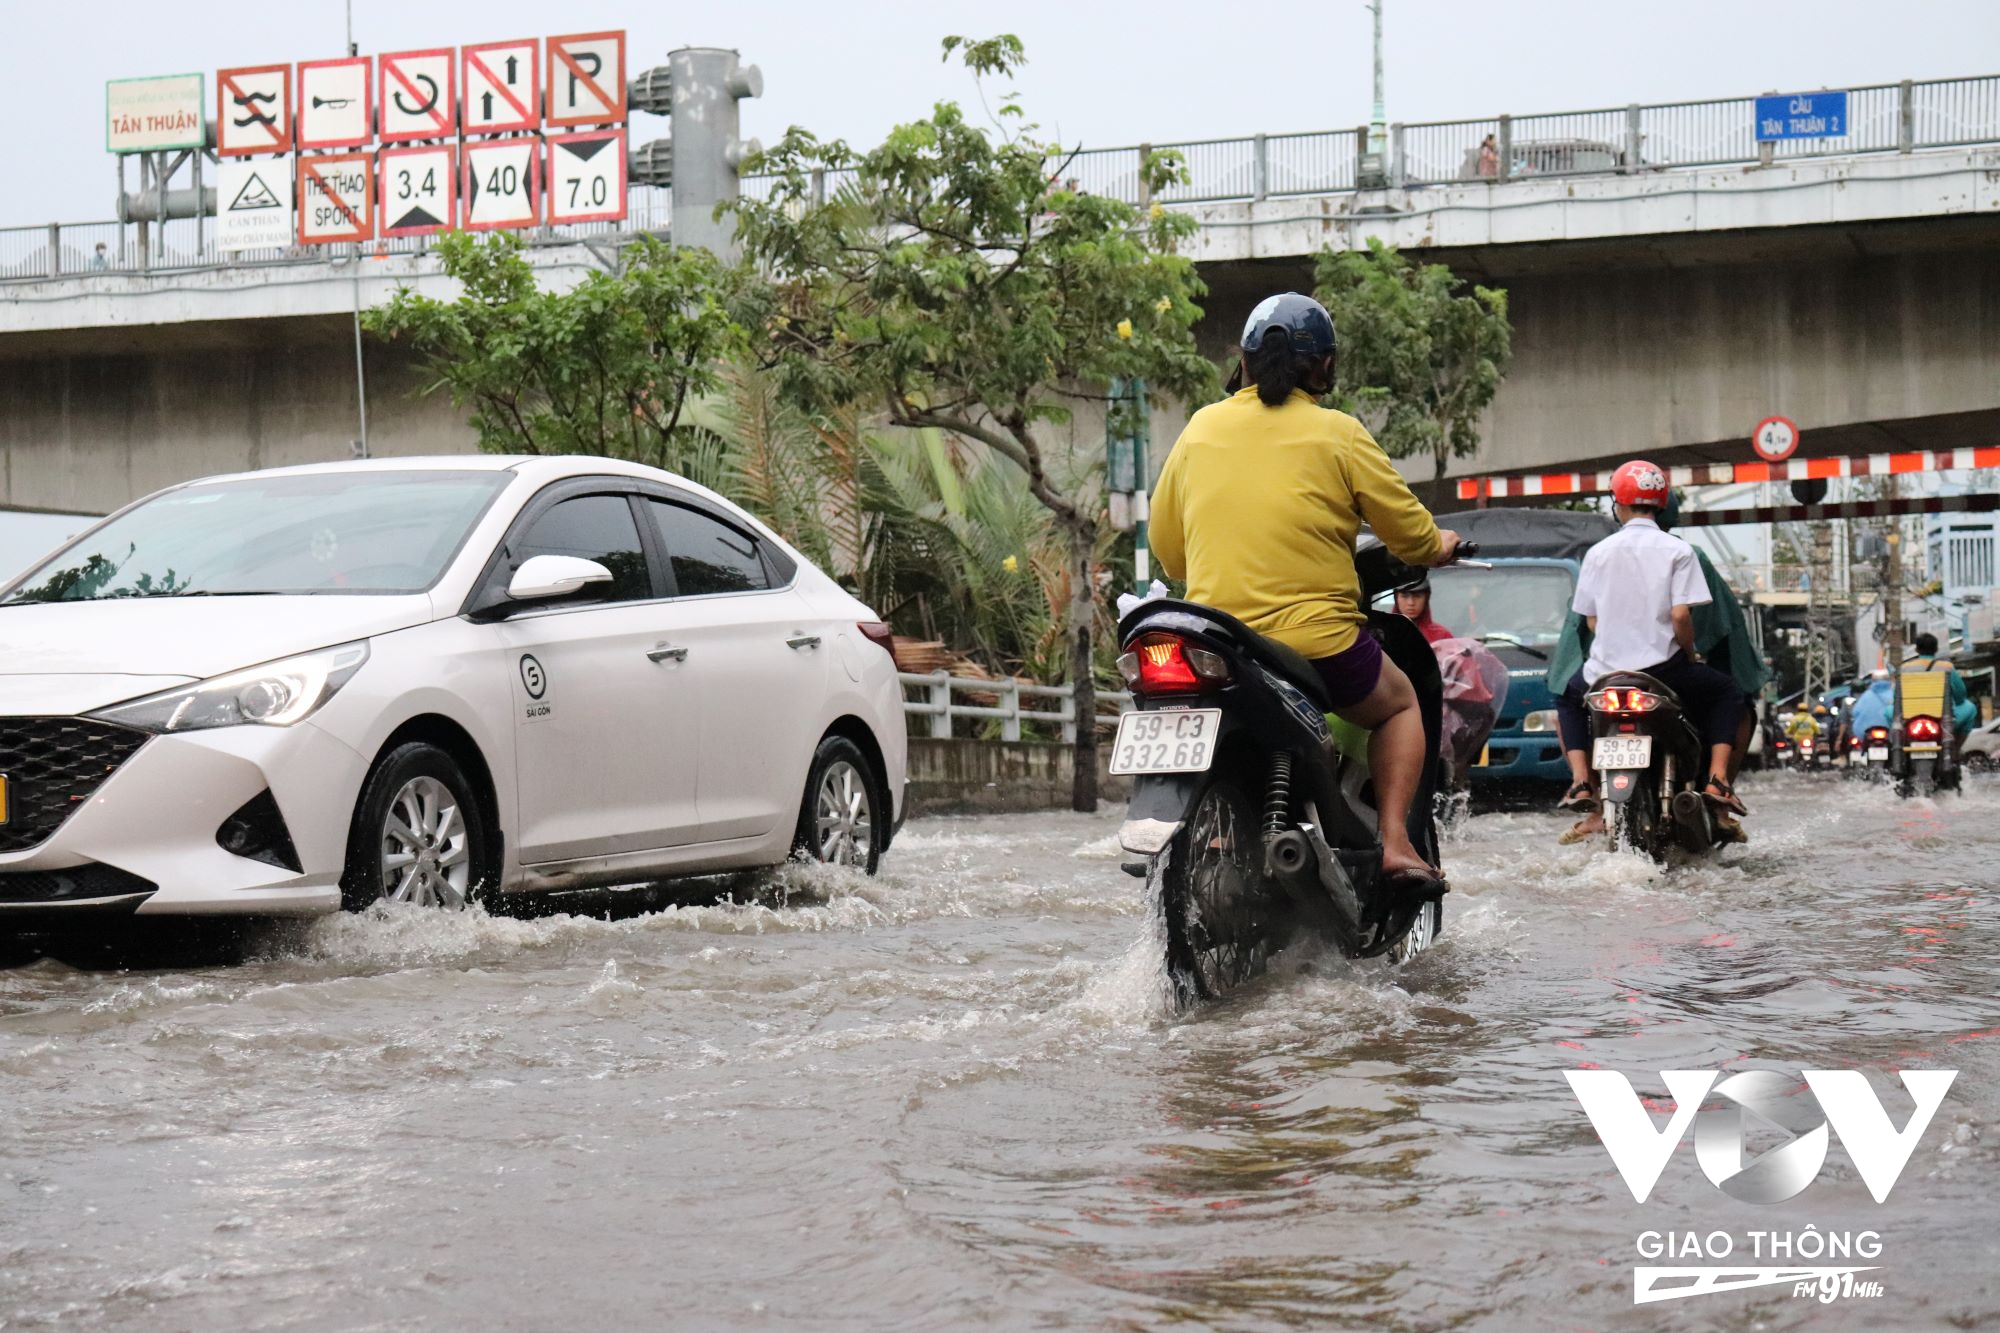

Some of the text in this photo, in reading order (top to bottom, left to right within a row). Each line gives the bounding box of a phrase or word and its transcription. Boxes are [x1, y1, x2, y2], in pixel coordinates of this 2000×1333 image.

[112, 109, 198, 134] TÂN THUẬN
[1831, 116, 1839, 131] 2
[398, 167, 436, 199] 3.4
[486, 165, 516, 197] 40
[566, 175, 606, 208] 7.0
[315, 205, 359, 227] SPORT
[1133, 715, 1205, 741] 59-C3
[1119, 742, 1206, 769] 332.68
[1603, 739, 1642, 752] 59-C2
[1596, 753, 1646, 767] 239.80
